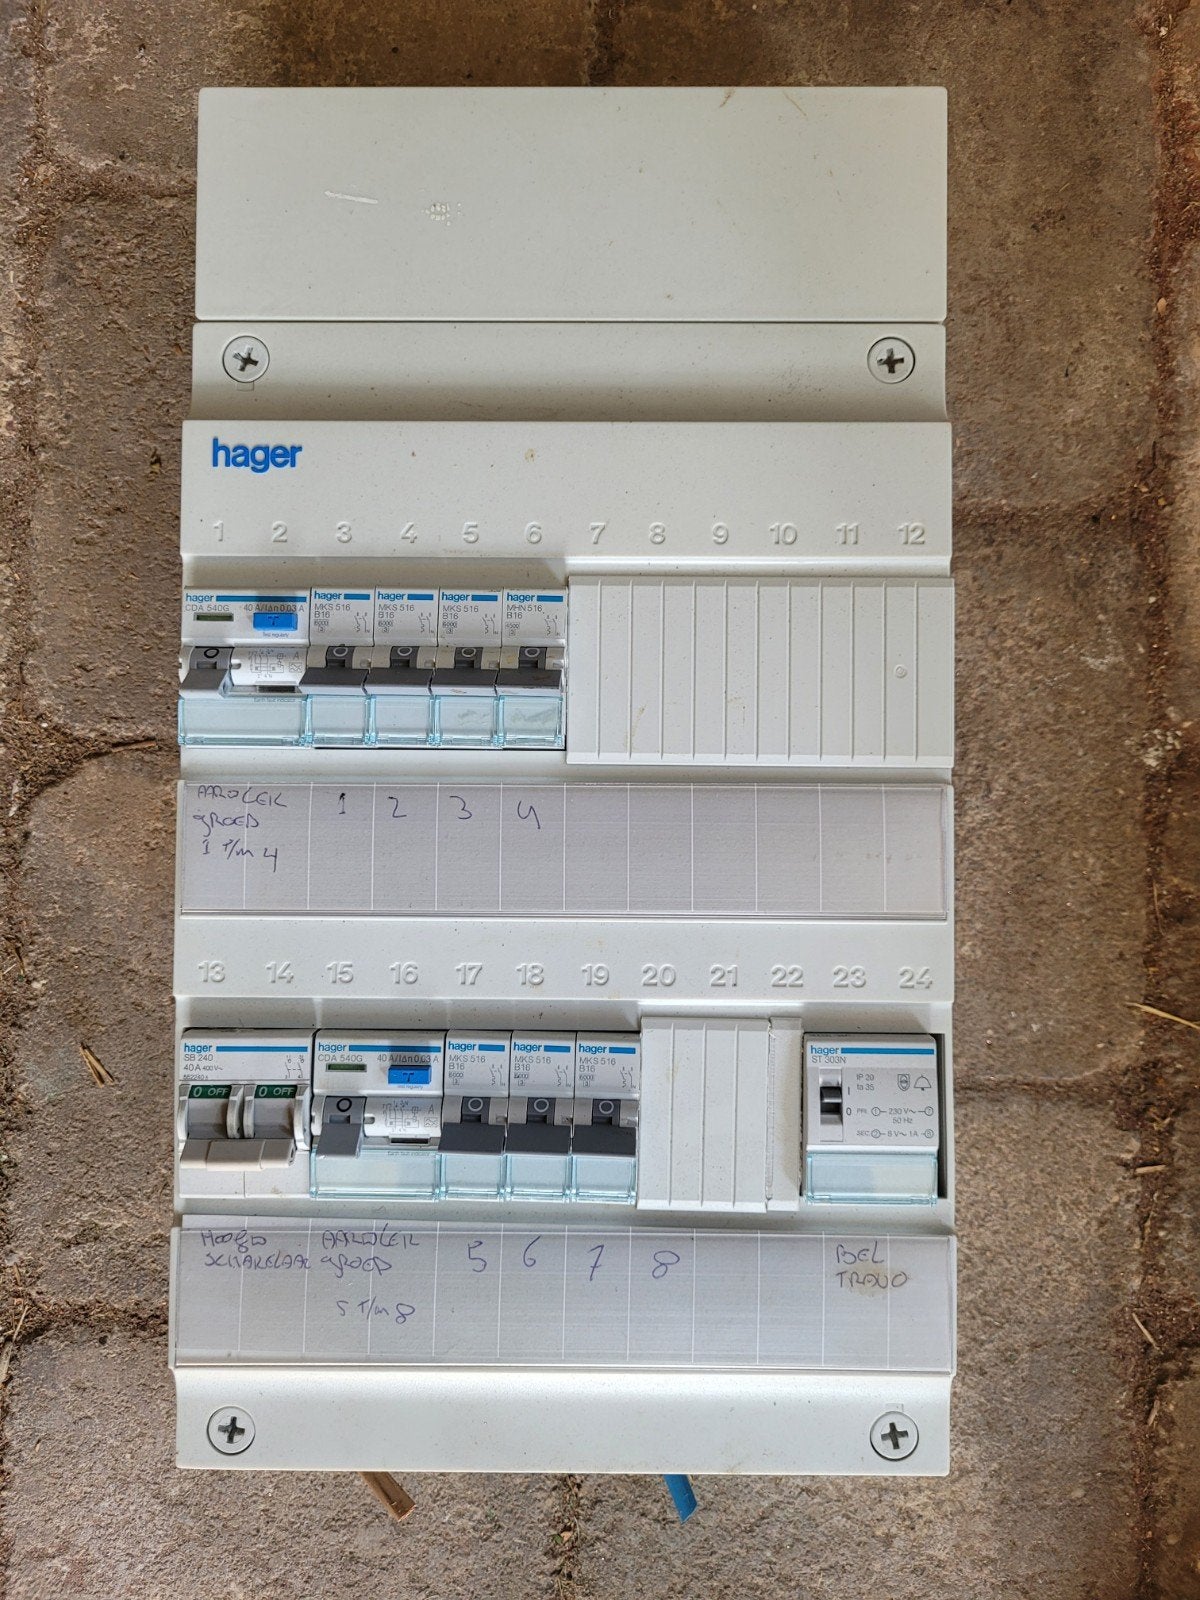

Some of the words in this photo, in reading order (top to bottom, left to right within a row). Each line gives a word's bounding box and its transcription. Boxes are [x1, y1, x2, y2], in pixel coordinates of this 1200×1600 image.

[212, 438, 302, 473] hager
[214, 521, 224, 542] 1
[272, 521, 288, 542] 2
[337, 522, 352, 543] 3
[400, 522, 418, 543] 4
[463, 522, 479, 543] 5
[525, 522, 542, 544] 6
[590, 523, 606, 544] 7
[649, 523, 666, 544] 8
[712, 523, 729, 544] 9
[770, 523, 798, 545] 10
[837, 523, 859, 544] 11
[898, 523, 925, 545] 12
[186, 593, 214, 604] hager
[314, 591, 342, 601] hager
[378, 591, 405, 601] hager
[442, 592, 469, 602] hager
[507, 593, 535, 602] hager
[338, 792, 347, 814] 1
[389, 797, 407, 818] 2
[450, 796, 472, 819] 3
[264, 847, 277, 872] 4
[198, 961, 225, 983] 13
[266, 962, 294, 984] 14
[327, 962, 353, 984] 15
[390, 962, 418, 984] 16
[456, 963, 482, 984] 17
[517, 963, 544, 986] 18
[582, 964, 609, 986] 19
[642, 964, 676, 986] 20
[711, 965, 738, 987] 21
[772, 966, 803, 988] 22
[833, 966, 866, 988] 23
[899, 967, 932, 989] 24
[184, 1043, 212, 1053] hager
[319, 1042, 347, 1053] hager
[448, 1041, 476, 1051] hager
[514, 1042, 542, 1052] hager
[579, 1044, 607, 1054] hager
[811, 1045, 839, 1055] hager
[318, 1054, 337, 1062] CDA
[208, 1087, 229, 1095] OFF
[273, 1087, 295, 1095] OFF
[836, 1240, 884, 1264] BEL
[467, 1239, 487, 1273] 5
[522, 1235, 540, 1267] 6
[587, 1244, 605, 1281] 7
[652, 1250, 680, 1279] 8
[396, 1303, 415, 1324] 8
